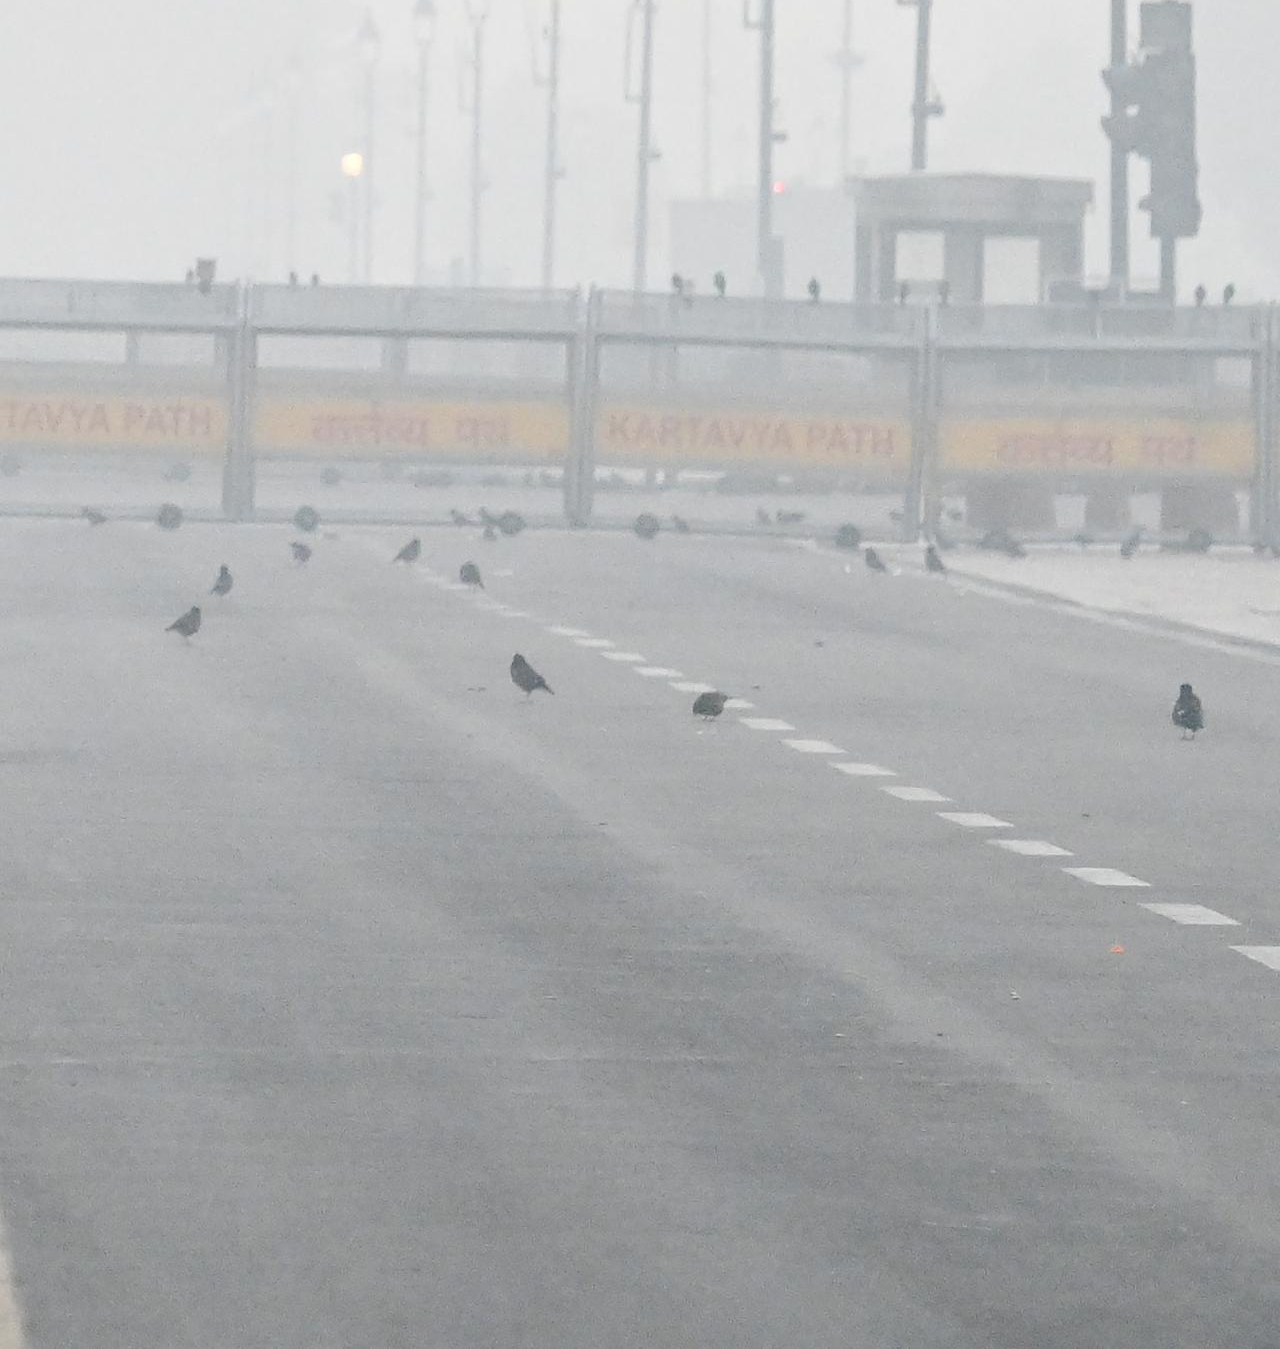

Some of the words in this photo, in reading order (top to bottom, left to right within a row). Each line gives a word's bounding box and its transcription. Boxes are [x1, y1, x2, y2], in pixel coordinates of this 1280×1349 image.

[120, 404, 209, 437] PATH
[607, 413, 791, 451] KARTAVYA
[804, 423, 893, 456] PATH
